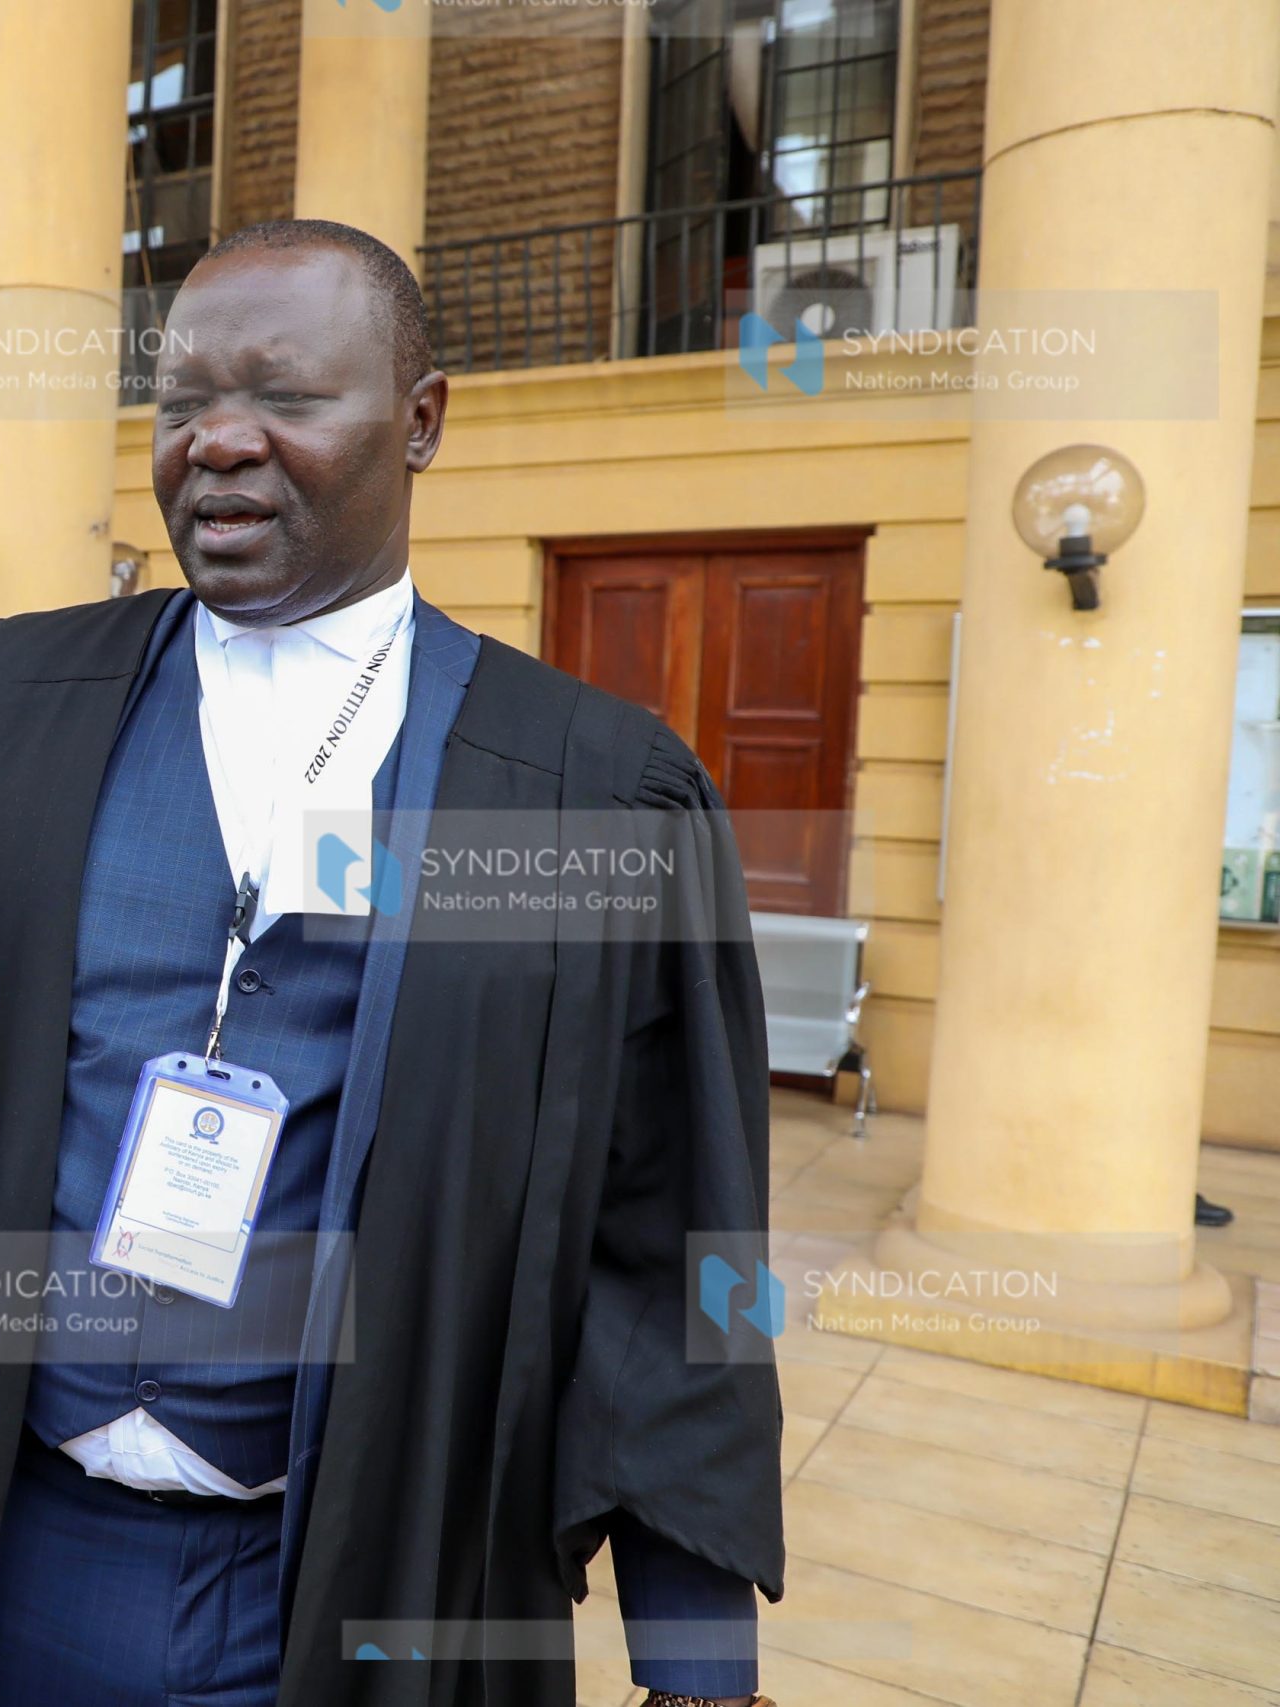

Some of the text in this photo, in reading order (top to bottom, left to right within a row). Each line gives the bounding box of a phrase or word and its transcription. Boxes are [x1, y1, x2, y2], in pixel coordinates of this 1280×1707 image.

[304, 633, 396, 785] TION PETITION 2022
